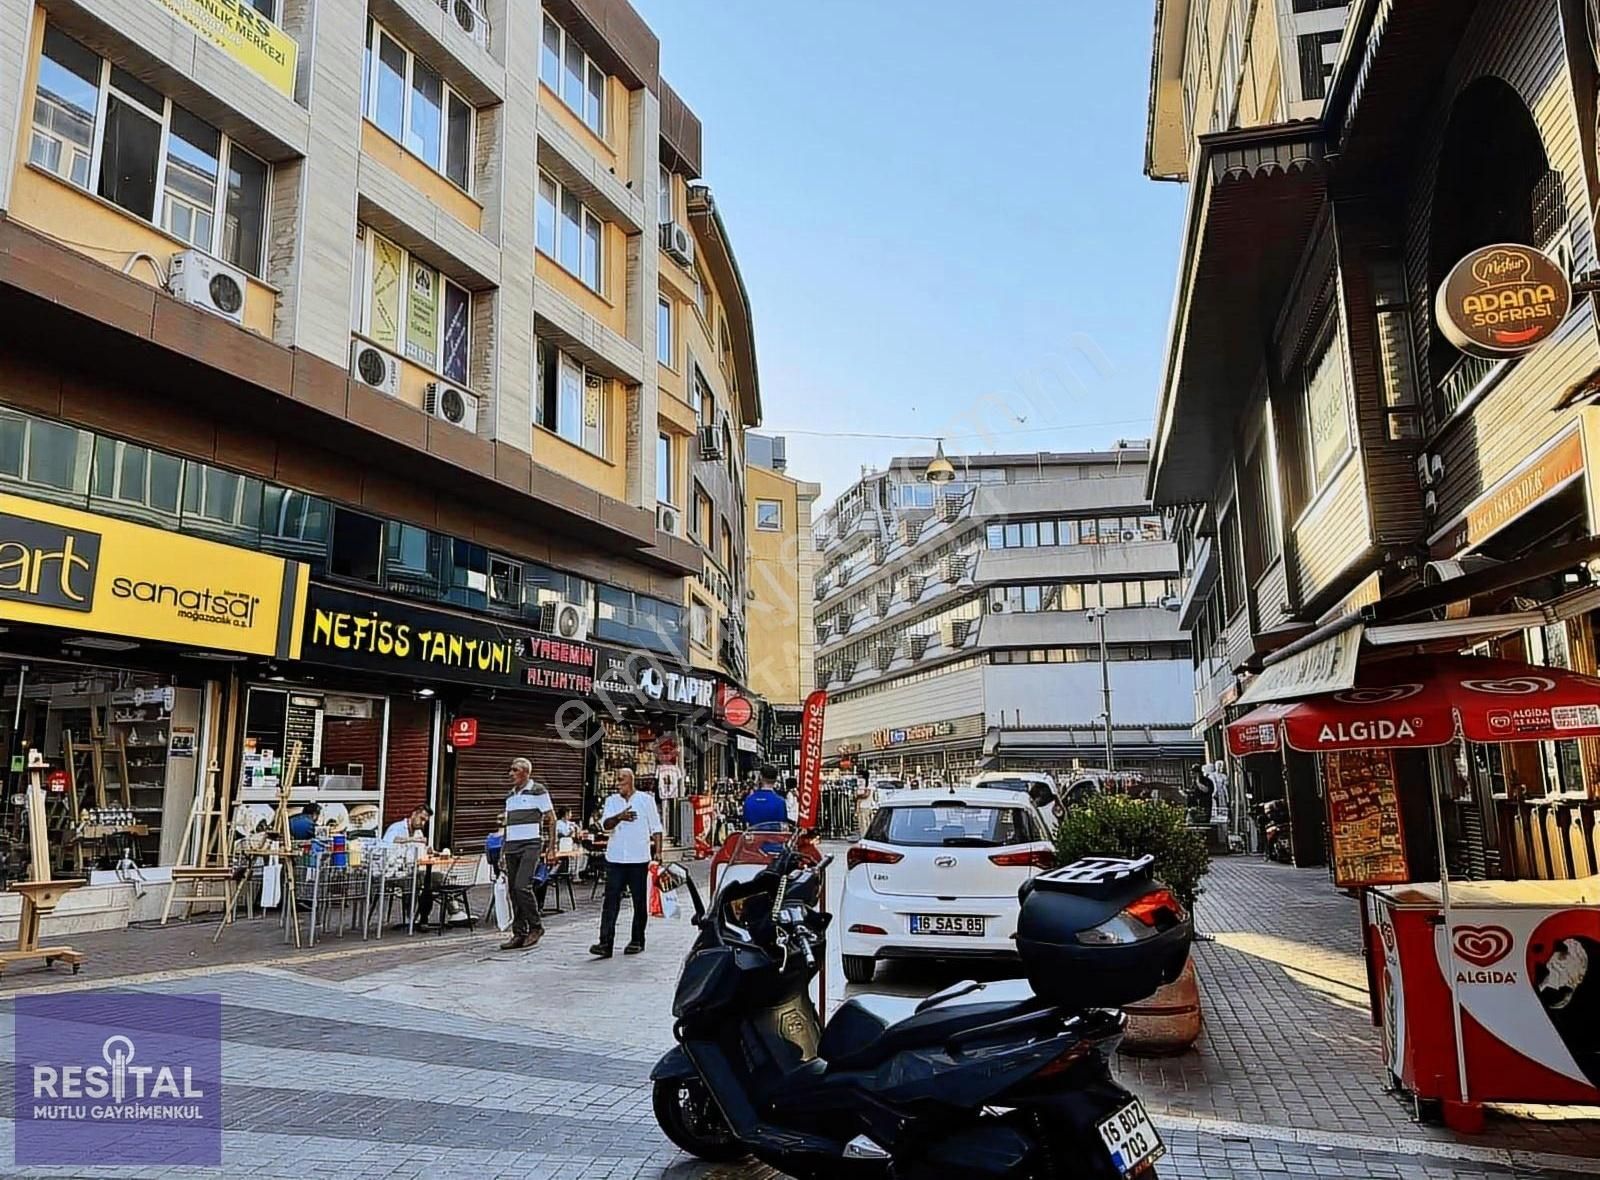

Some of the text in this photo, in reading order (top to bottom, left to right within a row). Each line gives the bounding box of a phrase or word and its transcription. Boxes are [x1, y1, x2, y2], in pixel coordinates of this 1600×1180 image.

[1463, 285, 1555, 315] ADANA
[1474, 304, 1551, 327] SOFRASI
[0, 535, 89, 601] art
[112, 577, 254, 628] sanatsal
[530, 637, 593, 667] YASEMİN
[799, 704, 820, 820] komagene
[919, 916, 982, 931] 16 SAS 85
[1102, 1121, 1121, 1146] 16
[1120, 1131, 1148, 1164] 703
